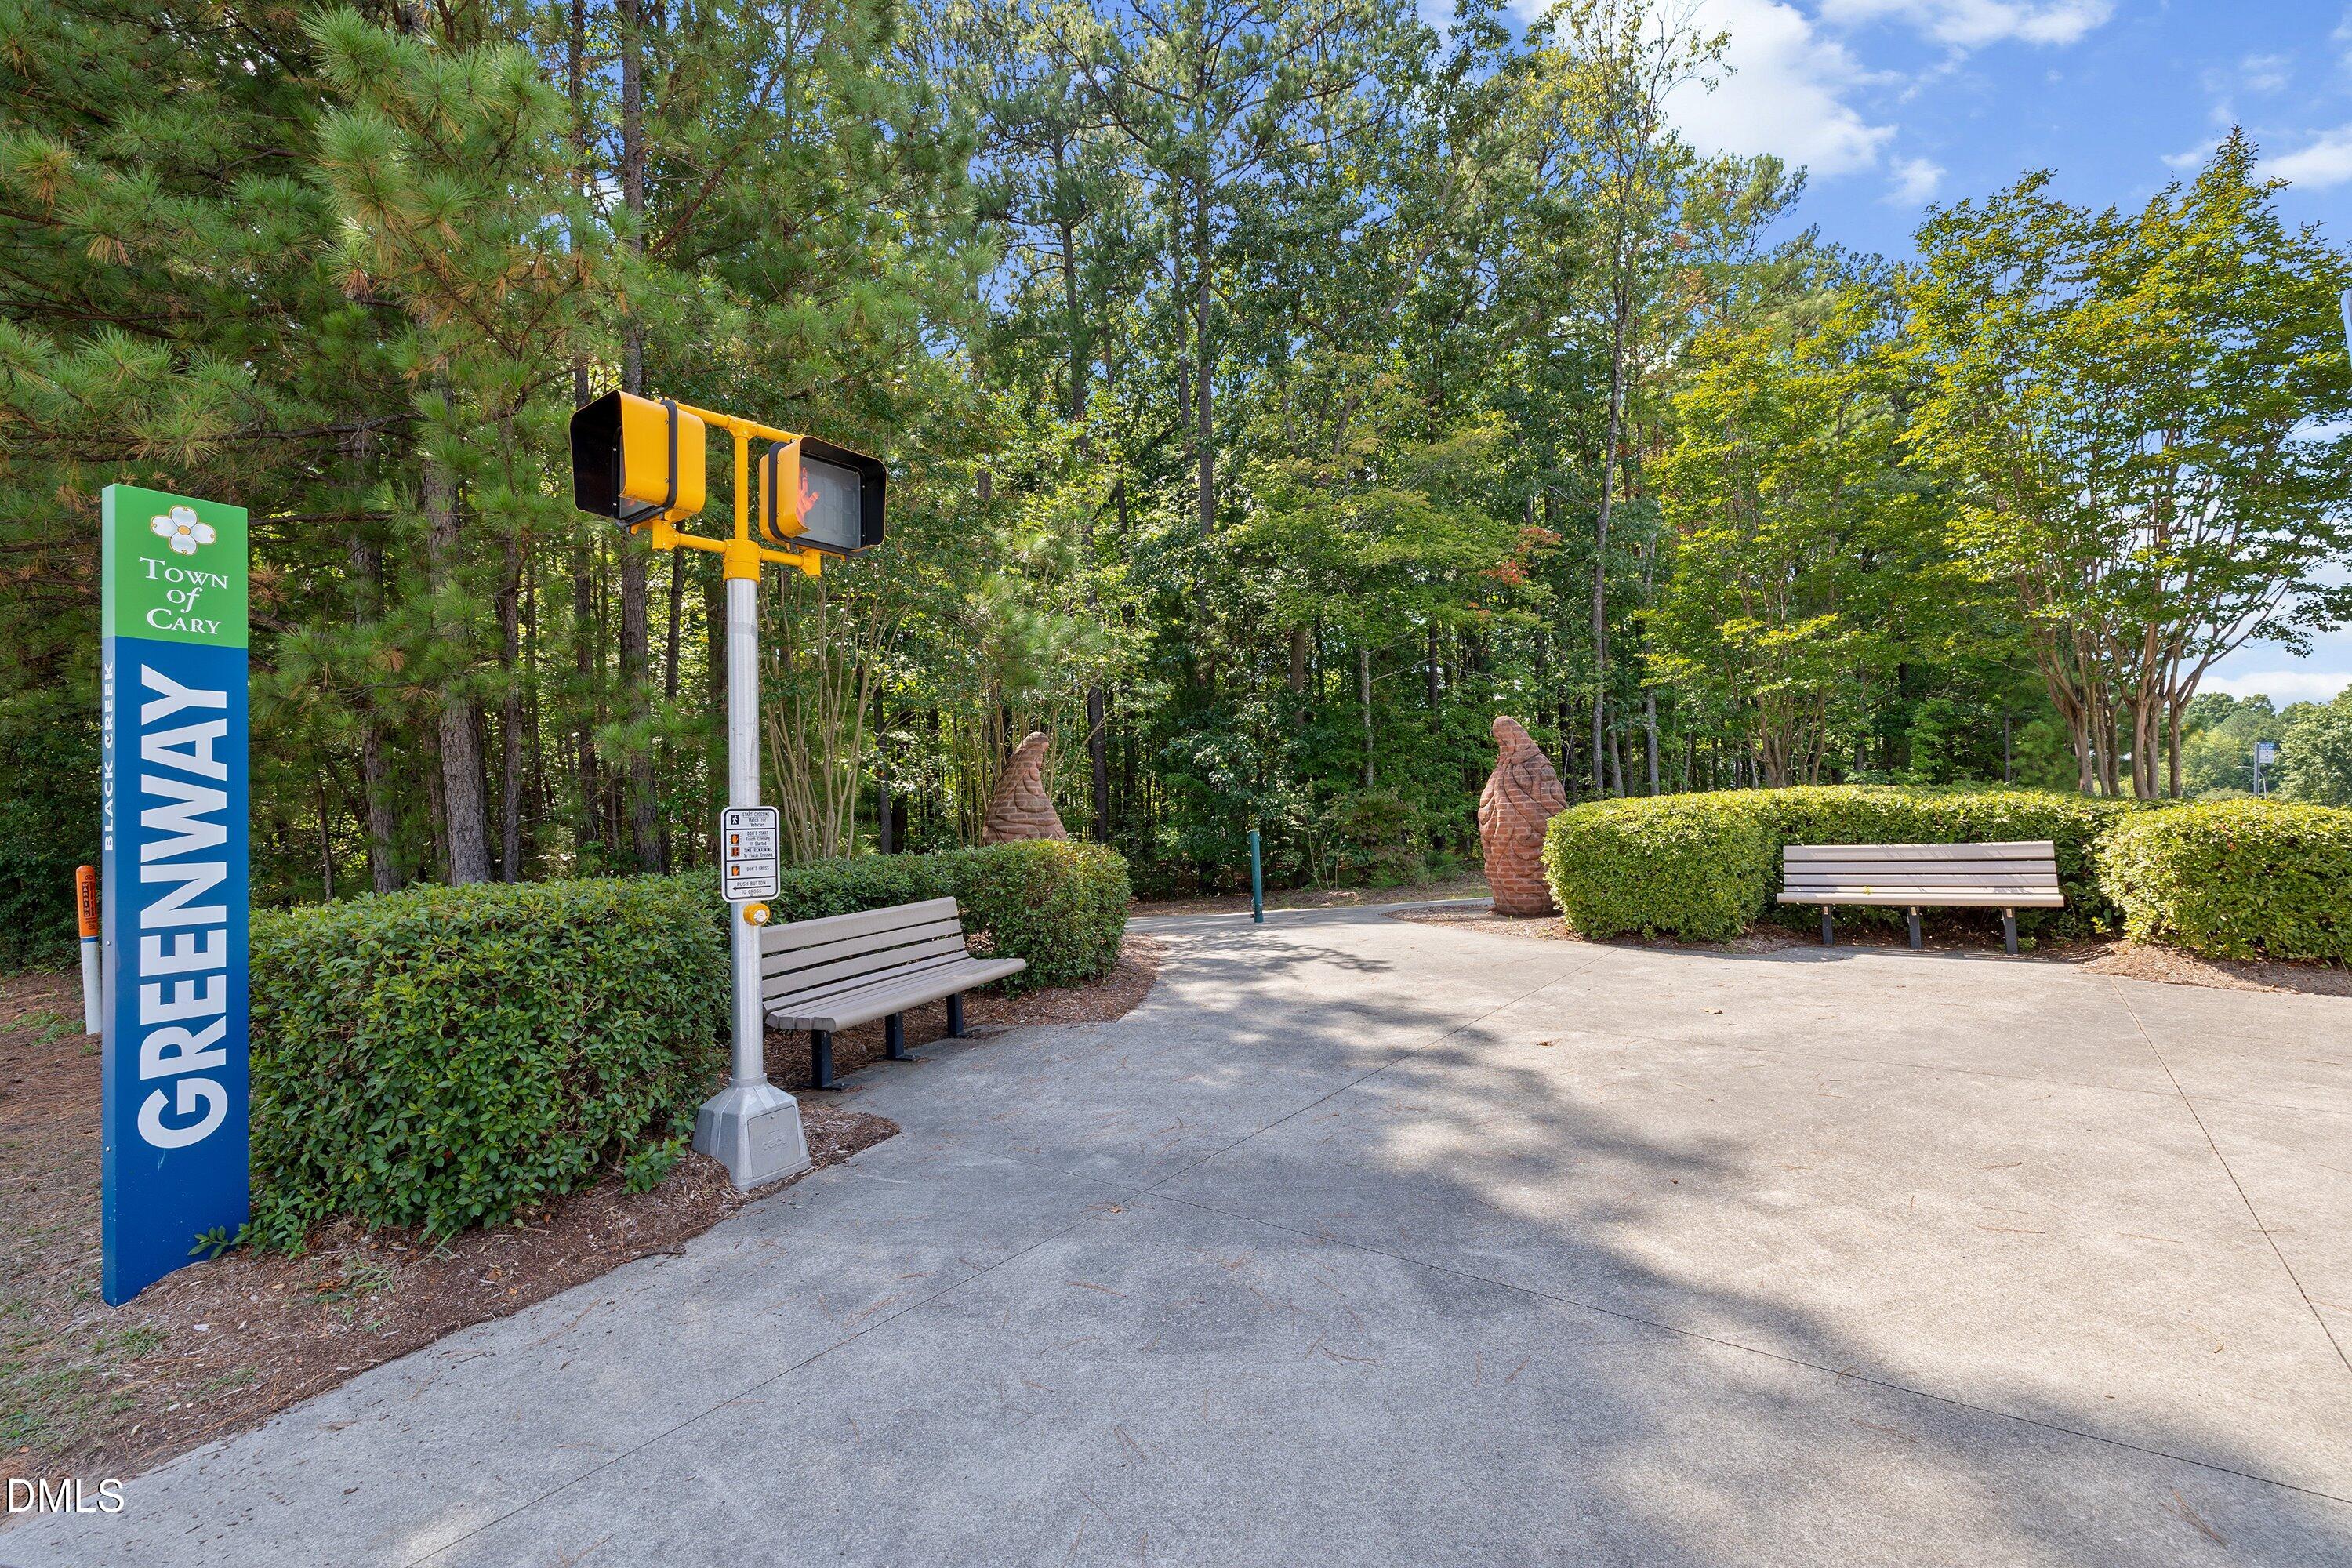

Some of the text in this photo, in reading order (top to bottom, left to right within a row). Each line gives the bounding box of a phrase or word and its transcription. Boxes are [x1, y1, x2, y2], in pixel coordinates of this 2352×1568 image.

[166, 587, 203, 613] of
[104, 662, 113, 851] BLACK CREEK
[137, 663, 228, 1149] GREENWAY
